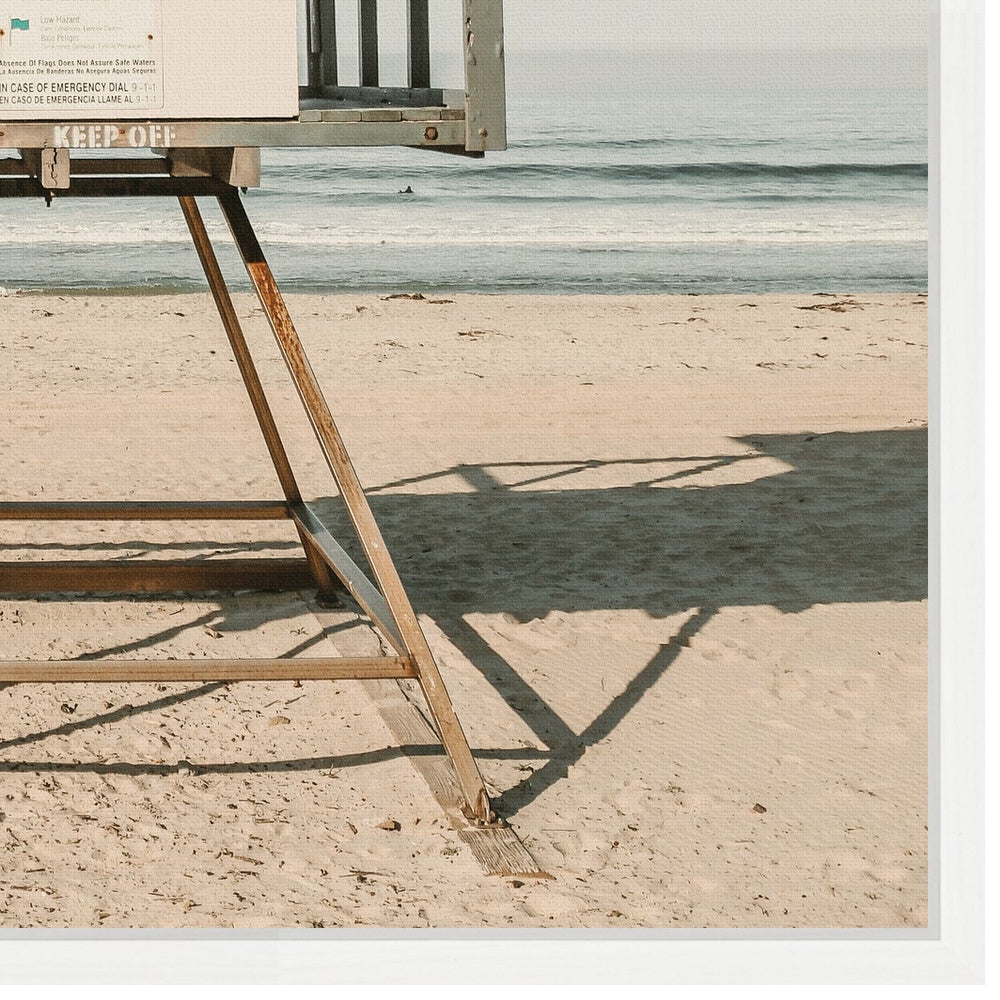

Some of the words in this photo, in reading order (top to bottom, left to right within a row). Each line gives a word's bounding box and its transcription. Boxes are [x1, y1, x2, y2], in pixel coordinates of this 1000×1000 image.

[40, 16, 54, 24] Low
[56, 16, 80, 24] Hazard
[28, 59, 36, 67] Of
[38, 59, 56, 67] Flags
[58, 59, 75, 67] Does
[77, 59, 89, 67] Not
[90, 59, 113, 67] Assure
[115, 58, 130, 66] Safe
[132, 58, 156, 67] Waters
[0, 83, 8, 92] IN
[10, 83, 34, 92] CASE
[36, 83, 49, 92] OF
[51, 83, 107, 93] EMERGENCY
[109, 83, 129, 92] DIAL
[131, 83, 157, 92] 9-1-1
[0, 96, 9, 104] EN
[11, 96, 32, 104] CASO
[34, 96, 44, 104] DE
[46, 96, 96, 104] EMERGENCIA
[98, 96, 123, 104] LLAME
[54, 125, 119, 148] KEEP
[128, 125, 176, 148] OFF
